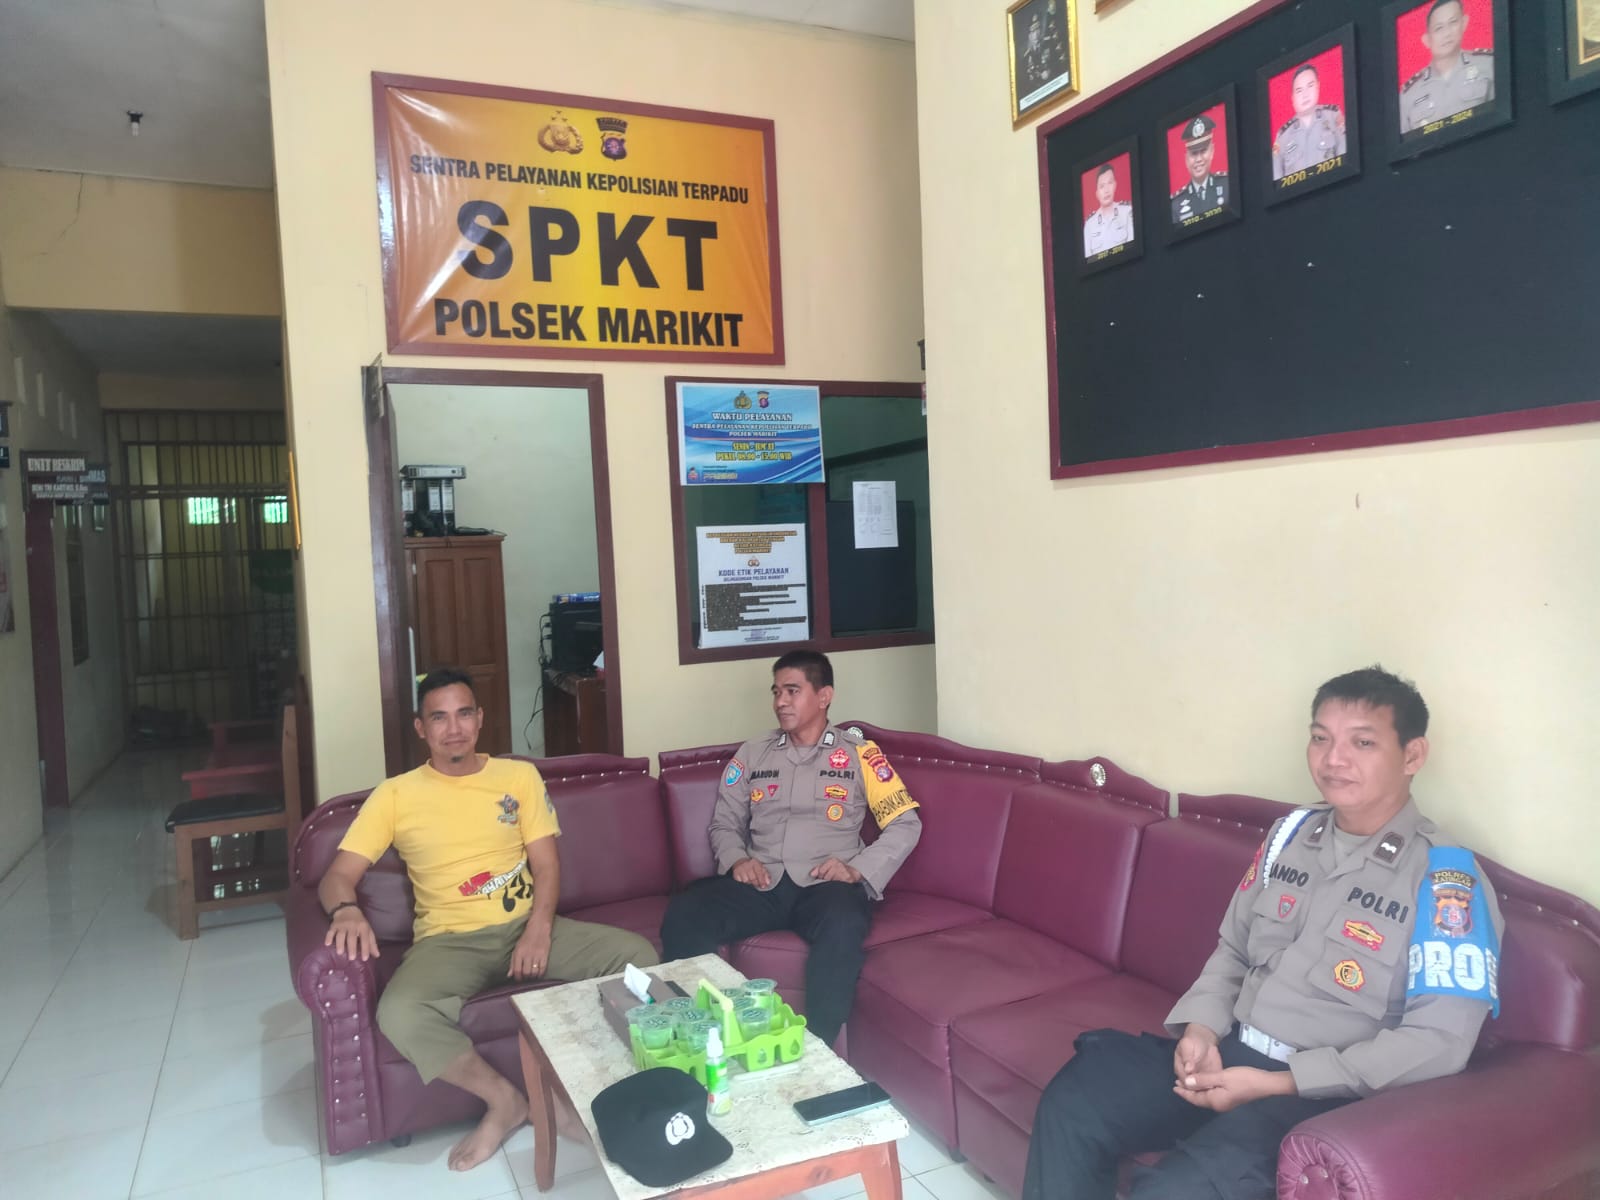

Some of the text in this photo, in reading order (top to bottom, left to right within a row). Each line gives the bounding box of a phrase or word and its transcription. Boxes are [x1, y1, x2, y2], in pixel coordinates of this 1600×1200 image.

[410, 154, 749, 204] SENTRA PELAYANAN KEPOLISIAN TERPADU
[1280, 170, 1306, 188] 2020
[1316, 157, 1343, 174] 2021
[457, 200, 718, 291] SPKT
[434, 298, 744, 347] POLSEK MARIKIT
[712, 412, 792, 421] WAKTU PELAYANAN
[27, 458, 51, 472] UNIT
[718, 567, 789, 577] KODE ETIK PELAYANAN
[820, 770, 855, 780] POLRI
[1347, 886, 1409, 925] POLRI
